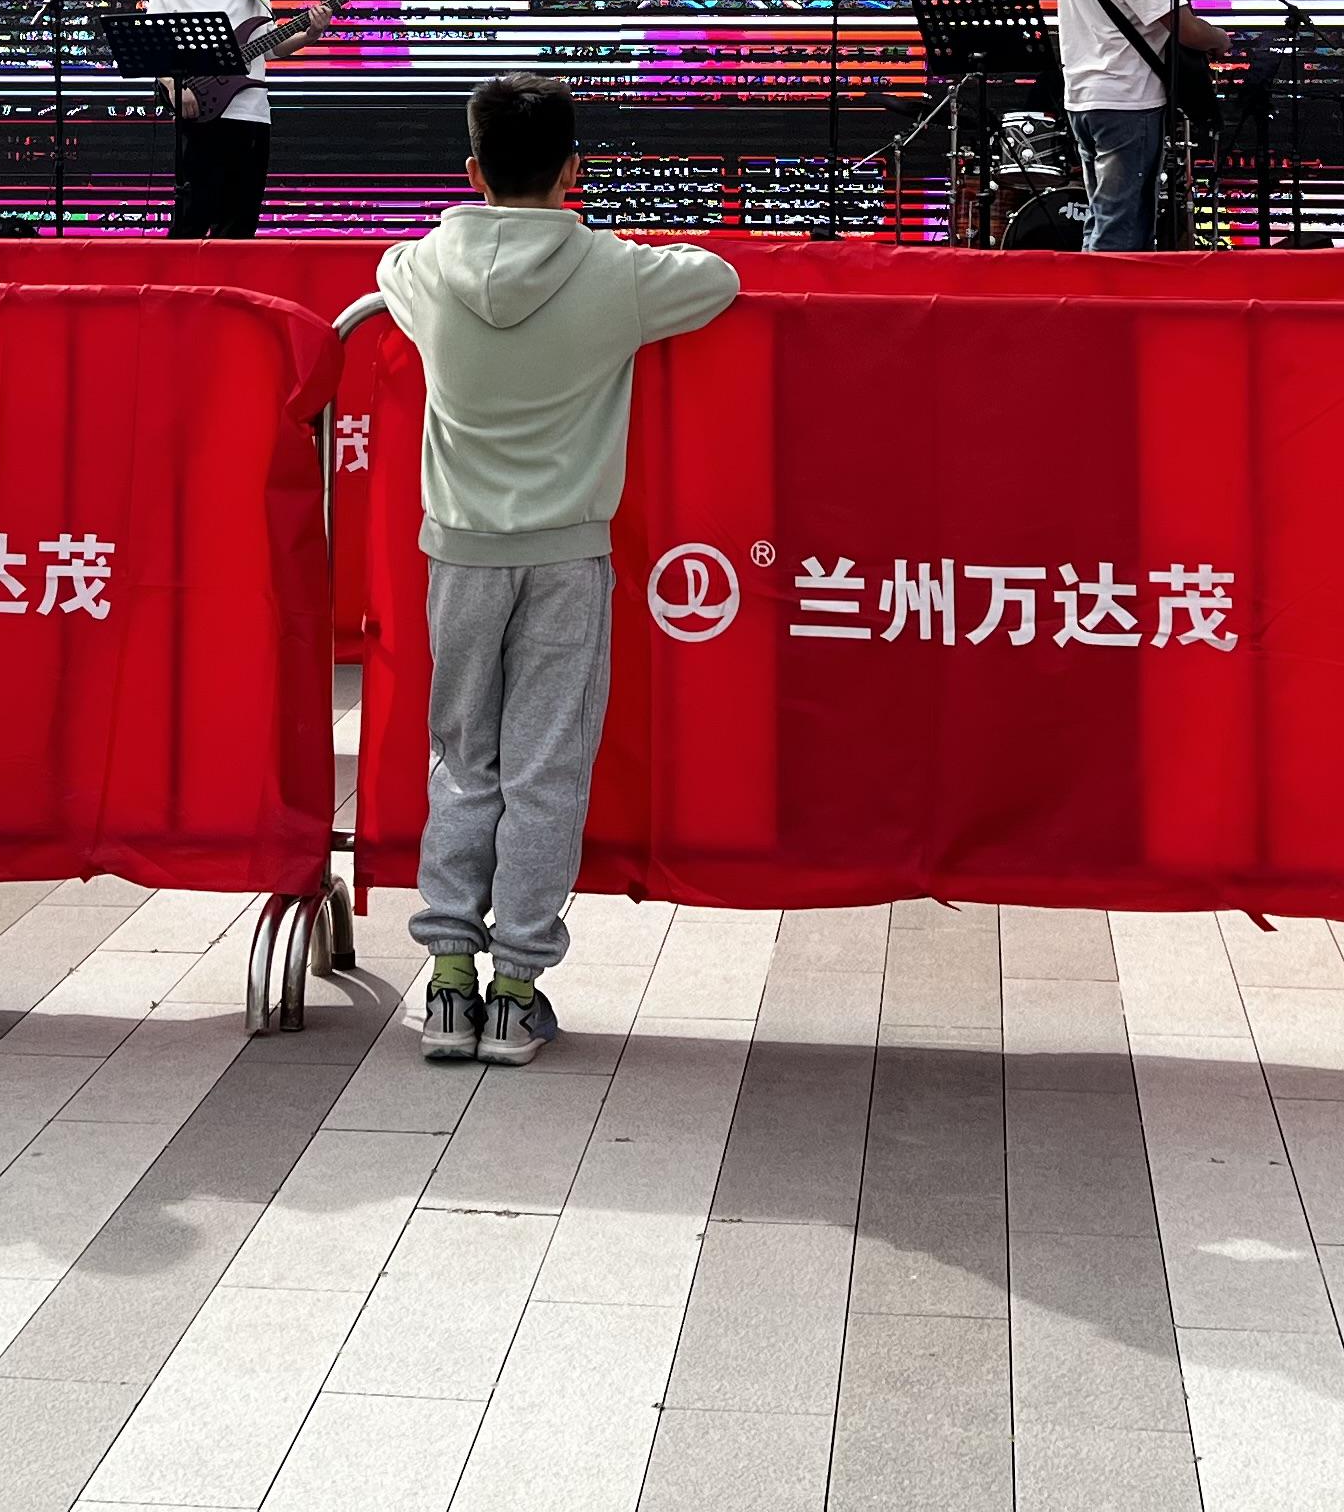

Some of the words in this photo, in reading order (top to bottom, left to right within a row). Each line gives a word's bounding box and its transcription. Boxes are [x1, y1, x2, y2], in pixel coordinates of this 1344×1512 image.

[789, 556, 1239, 652] 兰州万达茂
